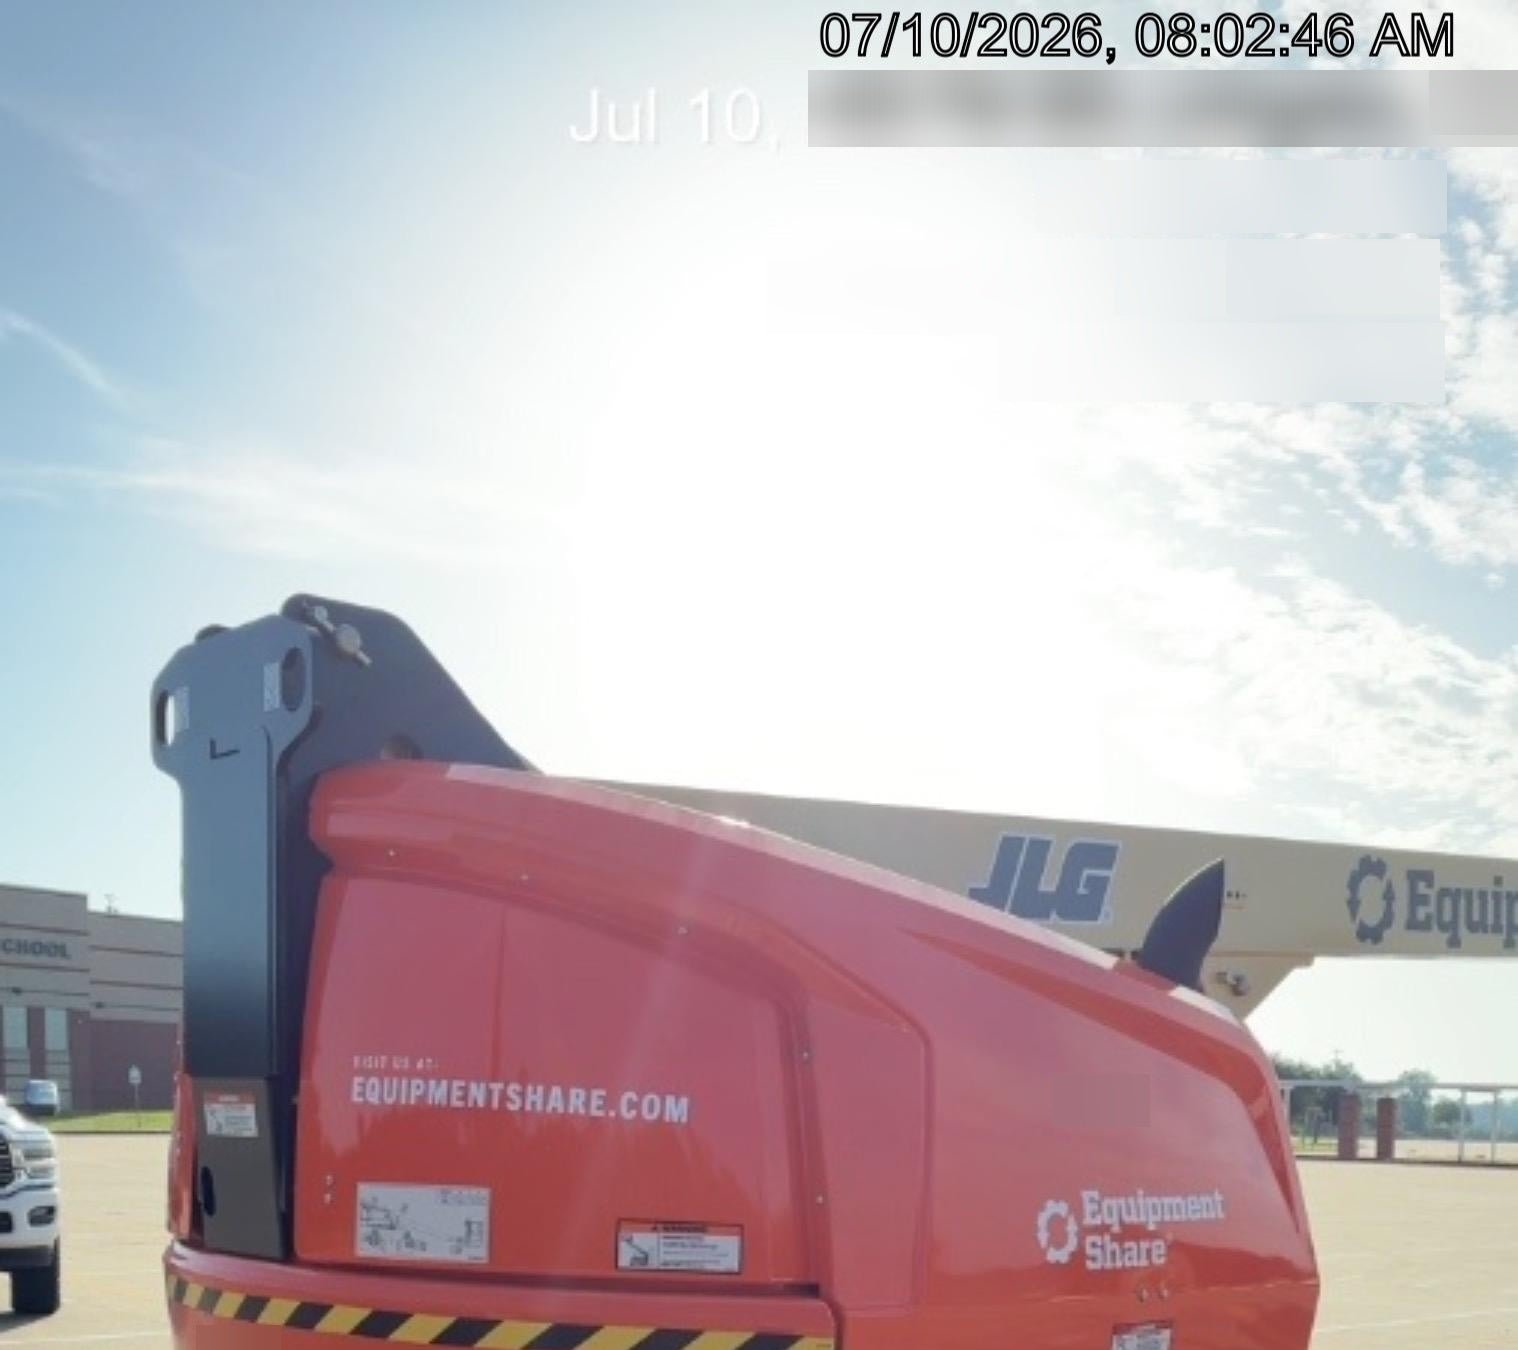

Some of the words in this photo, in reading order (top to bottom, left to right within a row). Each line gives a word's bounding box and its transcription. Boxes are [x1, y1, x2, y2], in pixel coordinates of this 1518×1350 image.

[967, 835, 1120, 922] JLG
[351, 1076, 690, 1123] EQUIPMENTSHARE.COM
[1081, 1189, 1225, 1233] Equipment
[1085, 1234, 1168, 1270] Share
